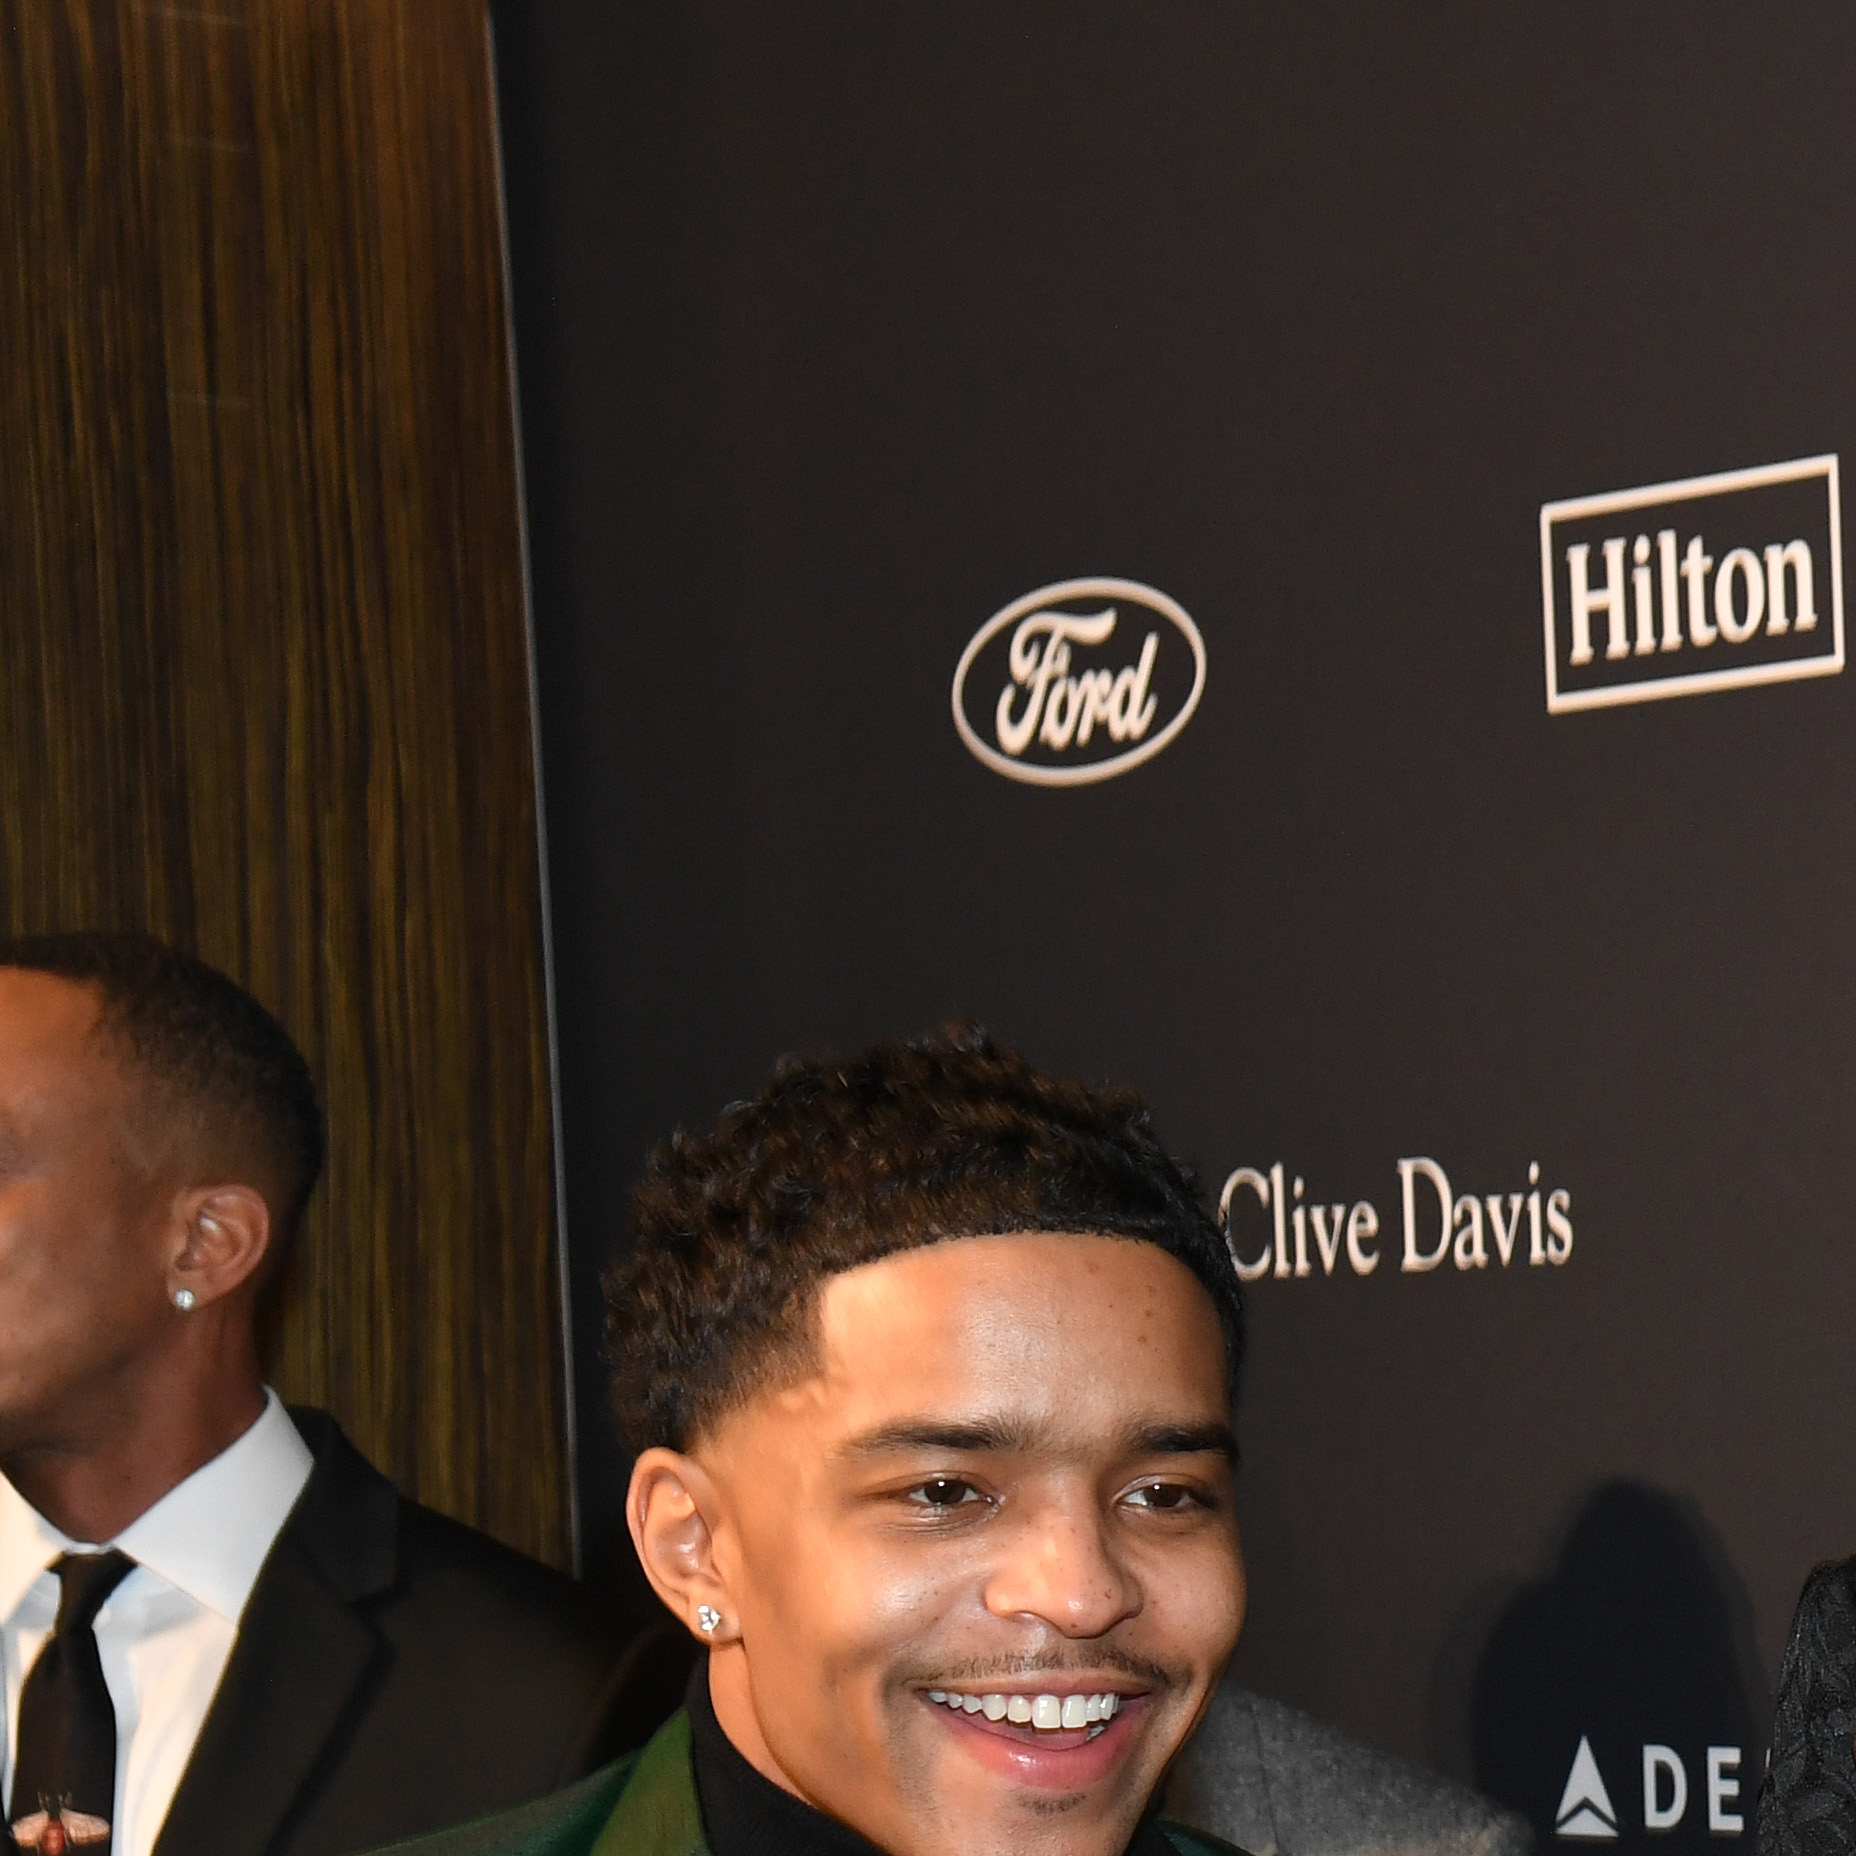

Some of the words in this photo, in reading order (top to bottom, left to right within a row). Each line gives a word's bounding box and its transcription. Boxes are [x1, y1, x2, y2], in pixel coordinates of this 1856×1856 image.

[1566, 529, 1817, 664] Hilton
[997, 608, 1157, 755] Ford
[1220, 1163, 1380, 1281] Clive
[1397, 1157, 1574, 1272] Davis
[1642, 1743, 1771, 1834] DE
